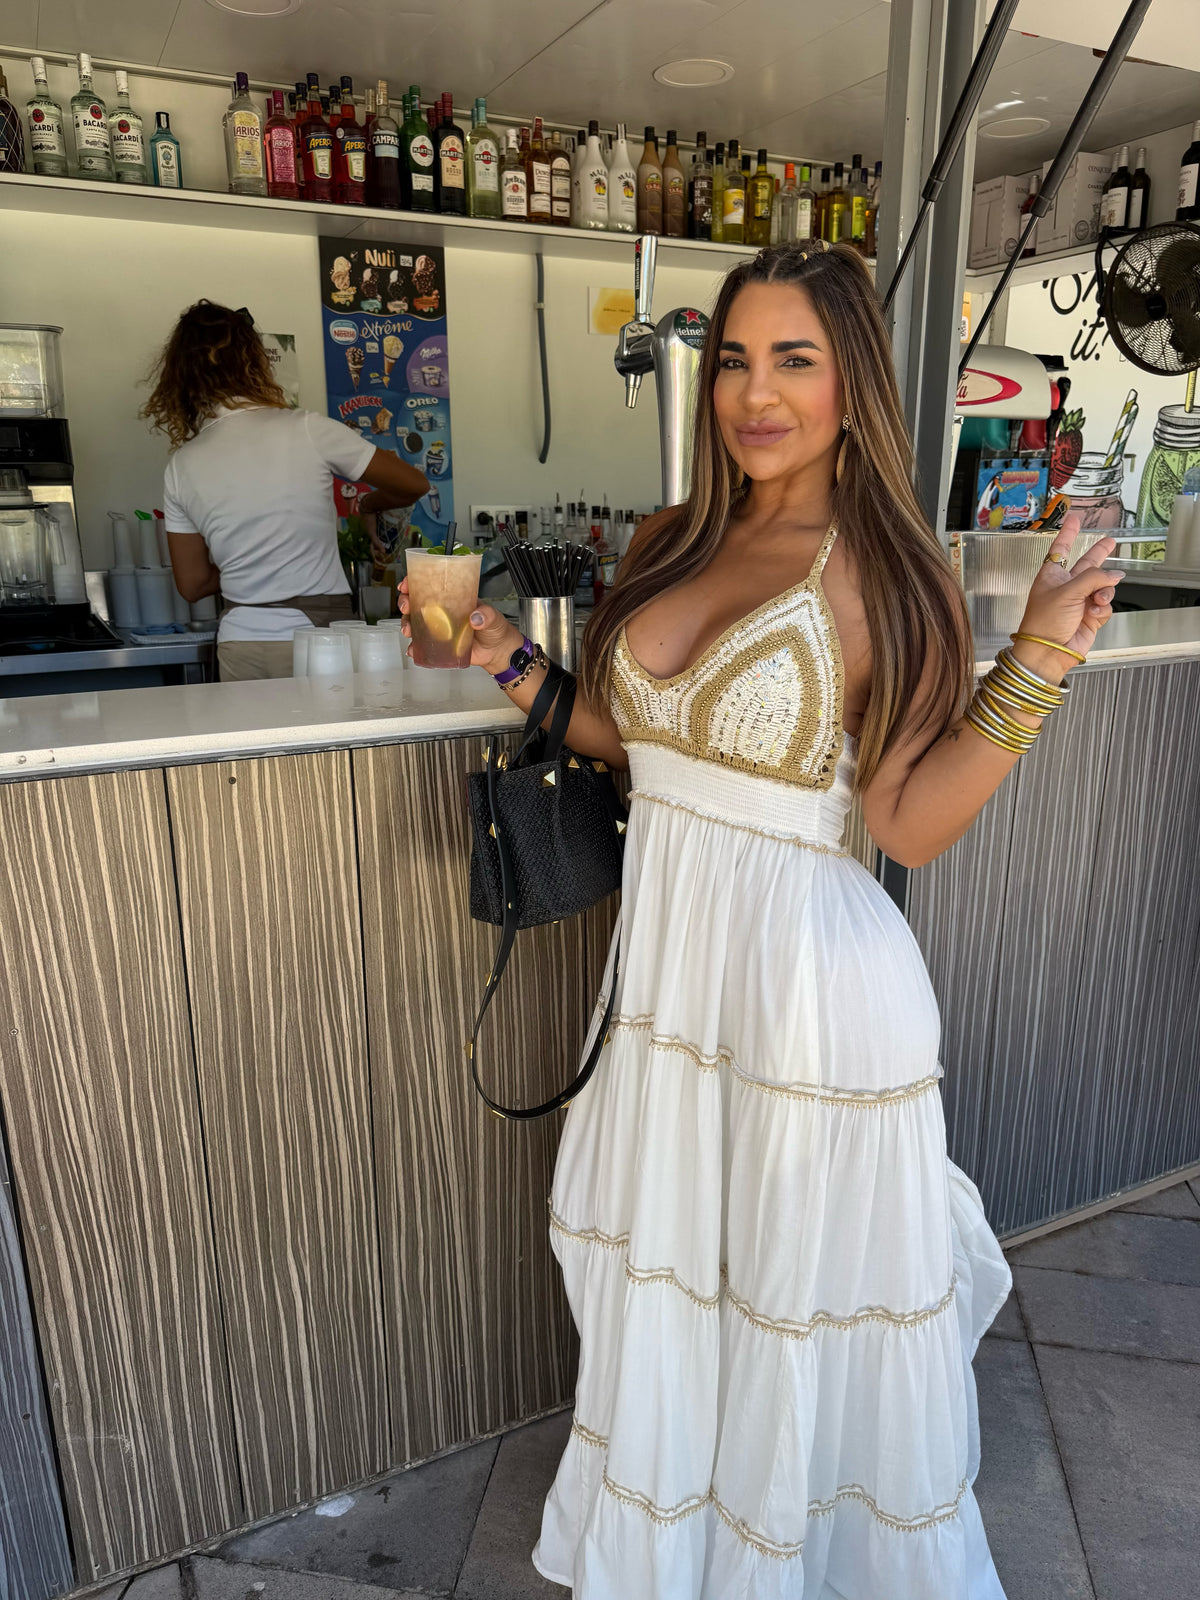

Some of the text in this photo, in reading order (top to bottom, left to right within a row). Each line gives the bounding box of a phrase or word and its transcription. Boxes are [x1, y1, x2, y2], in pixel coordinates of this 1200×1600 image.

[83, 119, 107, 130] BACARD
[233, 126, 260, 138] LARIOS
[365, 249, 395, 268] Nuii
[676, 327, 706, 336] Heinek
[420, 347, 442, 359] Milka
[338, 395, 383, 419] MAXIBON
[406, 397, 439, 409] OREO
